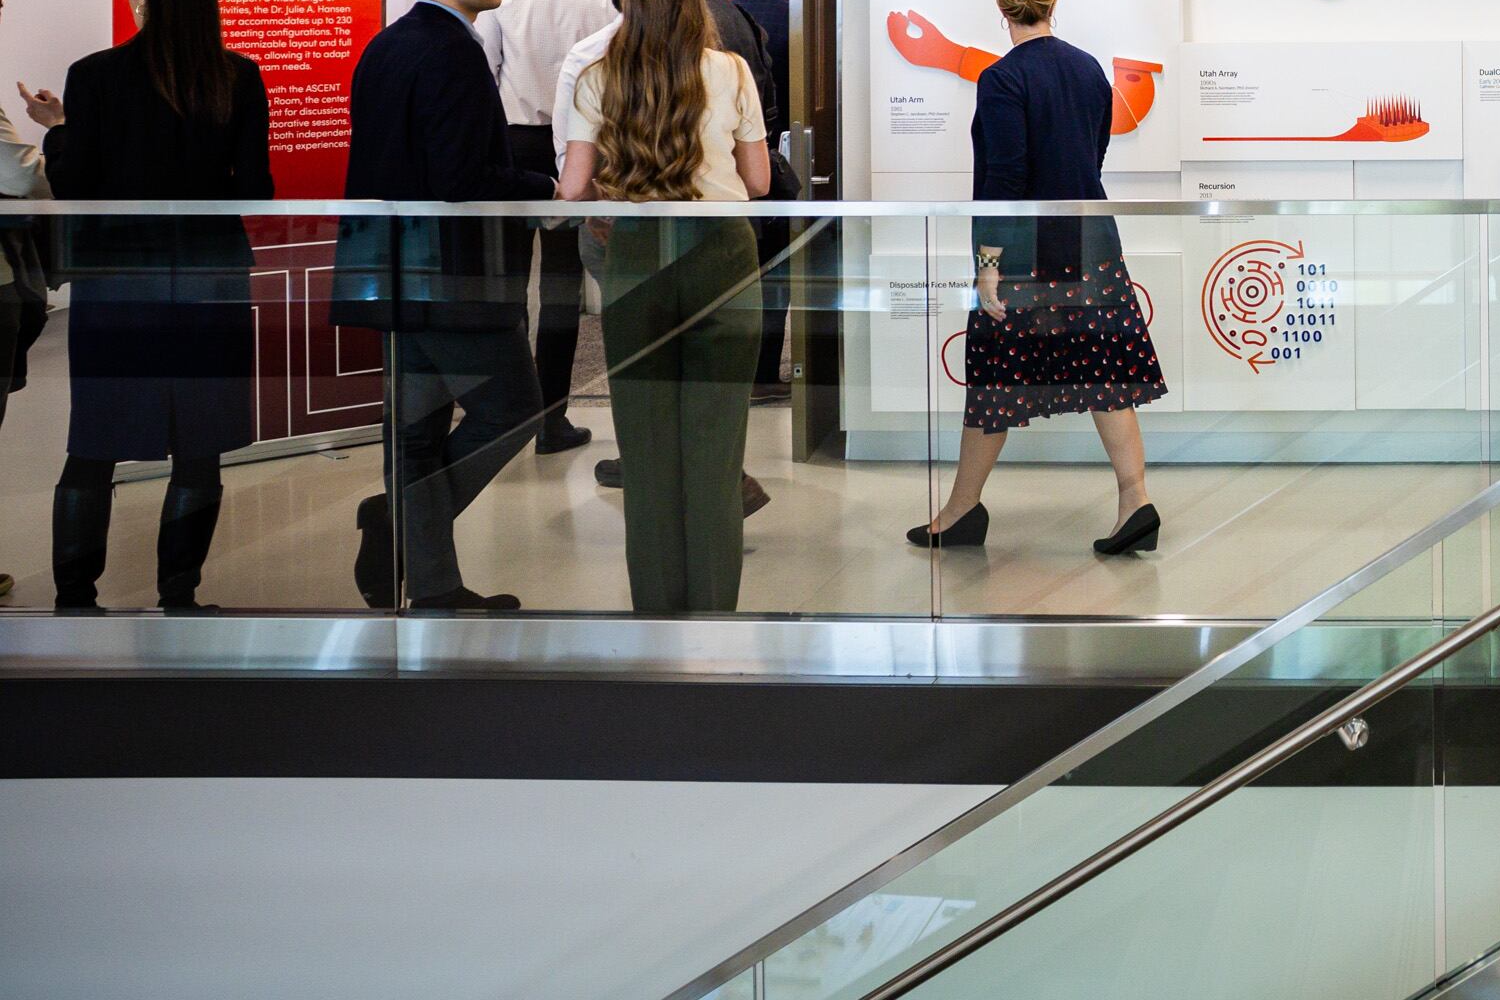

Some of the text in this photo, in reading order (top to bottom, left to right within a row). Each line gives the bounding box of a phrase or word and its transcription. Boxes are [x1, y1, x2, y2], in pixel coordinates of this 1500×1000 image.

[220, 5, 351, 15] tivities, the Dr. Julie A. Hansen
[238, 17, 310, 26] accommodates
[311, 17, 324, 26] up
[325, 16, 334, 24] to
[336, 16, 353, 24] 230
[229, 29, 265, 39] seating
[266, 27, 332, 37] configurations.
[333, 26, 351, 35] The
[225, 38, 352, 49] customizable layout and full
[264, 51, 303, 61] allowing
[304, 50, 311, 58] it
[312, 50, 321, 58] to
[323, 50, 350, 59] adapt
[282, 62, 313, 70] needs.
[1218, 70, 1238, 78] Array
[267, 83, 341, 94] with the ASCENT
[273, 96, 303, 106] Room,
[305, 96, 320, 104] the
[321, 95, 349, 103] center
[284, 107, 297, 116] for
[299, 107, 351, 116] discussions,
[269, 118, 349, 129] borative sessions.
[273, 130, 294, 140] both
[296, 128, 352, 139] independent
[269, 141, 350, 153] rning experiences.
[1198, 182, 1236, 190] Recursion
[1298, 263, 1326, 275] 101
[948, 281, 969, 289] Mask
[1286, 313, 1335, 326] 01011
[1282, 330, 1322, 343] 1100
[1271, 347, 1300, 359] 001
